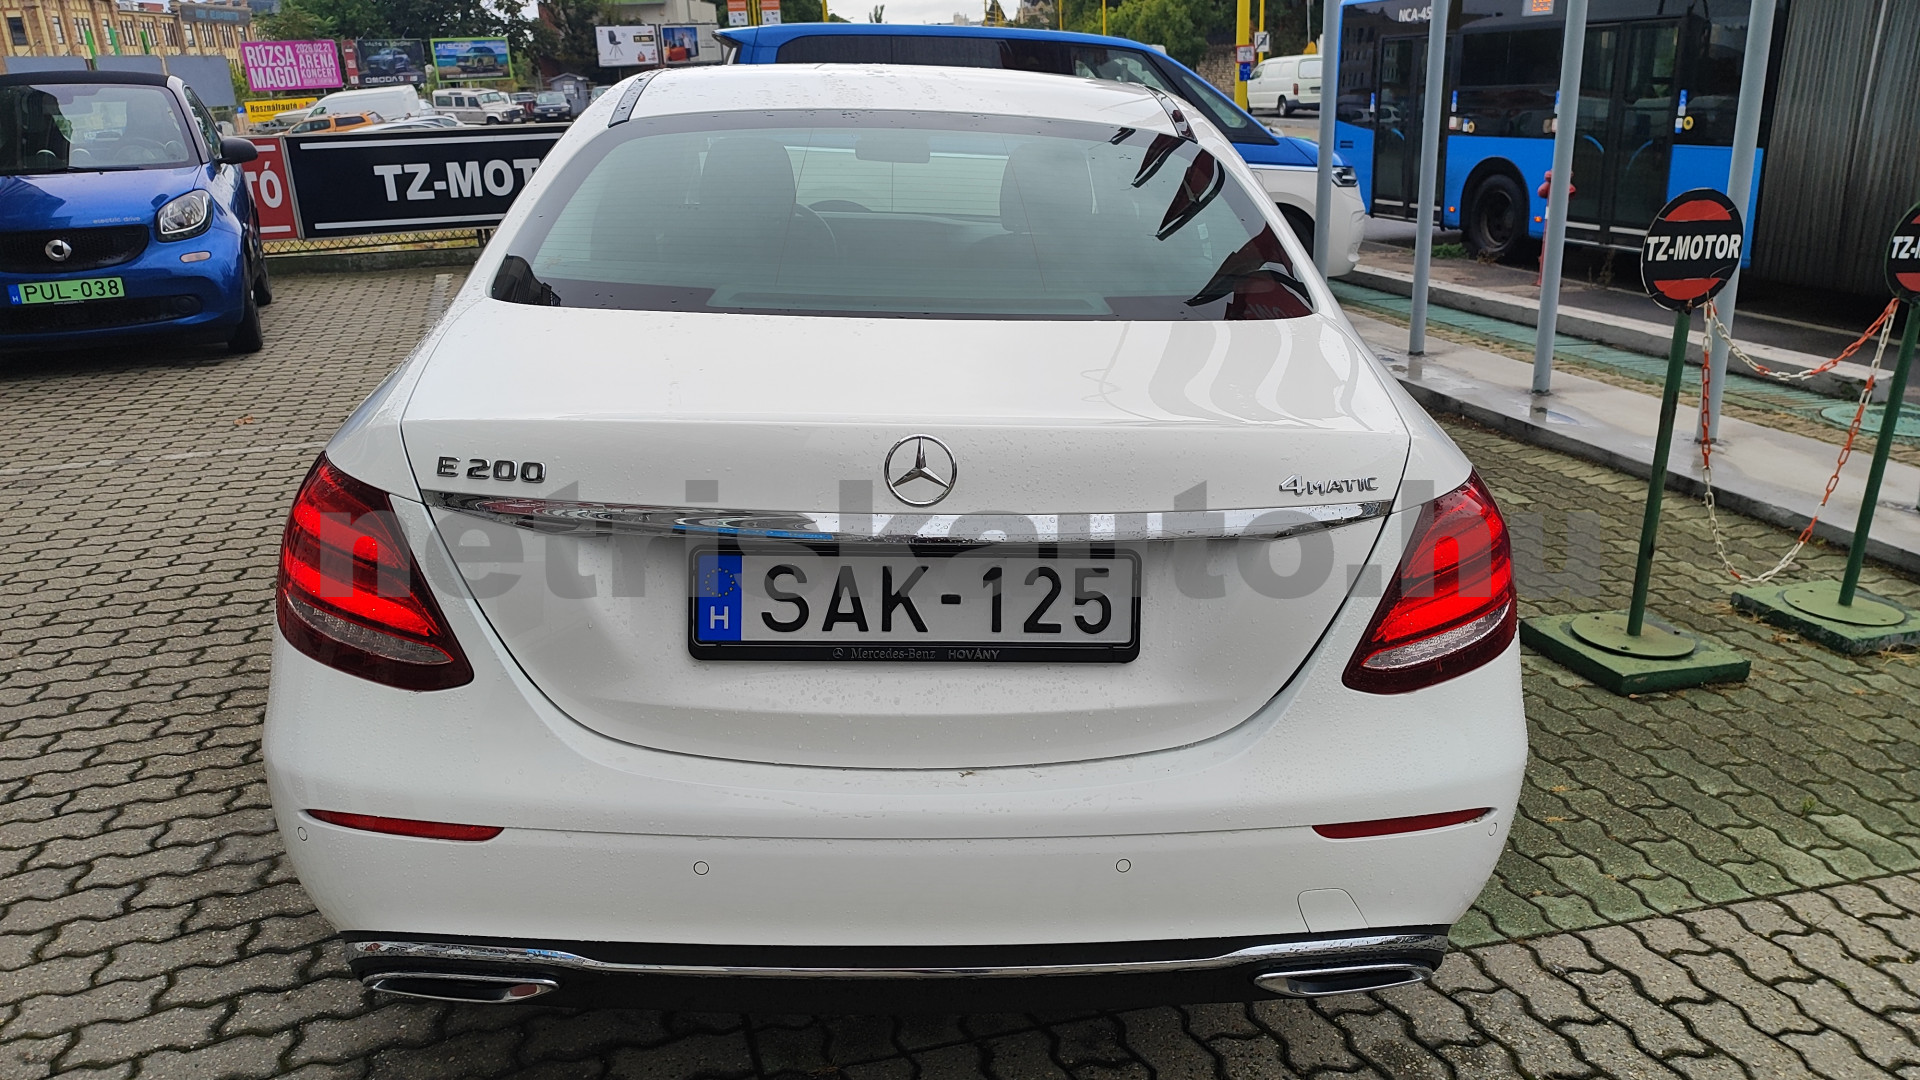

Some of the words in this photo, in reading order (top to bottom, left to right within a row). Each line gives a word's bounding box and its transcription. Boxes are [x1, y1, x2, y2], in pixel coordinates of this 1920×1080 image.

[245, 44, 297, 67] RÚZSA
[250, 66, 301, 89] MAGDI
[301, 67, 337, 79] KONCERT
[1646, 234, 1742, 262] TZ-MOTOR
[23, 280, 120, 302] PUL-038
[437, 456, 460, 477] E
[466, 458, 546, 483] 200
[1279, 474, 1379, 496] 4MATIC
[709, 606, 729, 630] H
[761, 564, 1112, 634] SAK-125
[850, 647, 936, 660] Mercedes-Benz
[948, 649, 1000, 661] HOVÁNY
